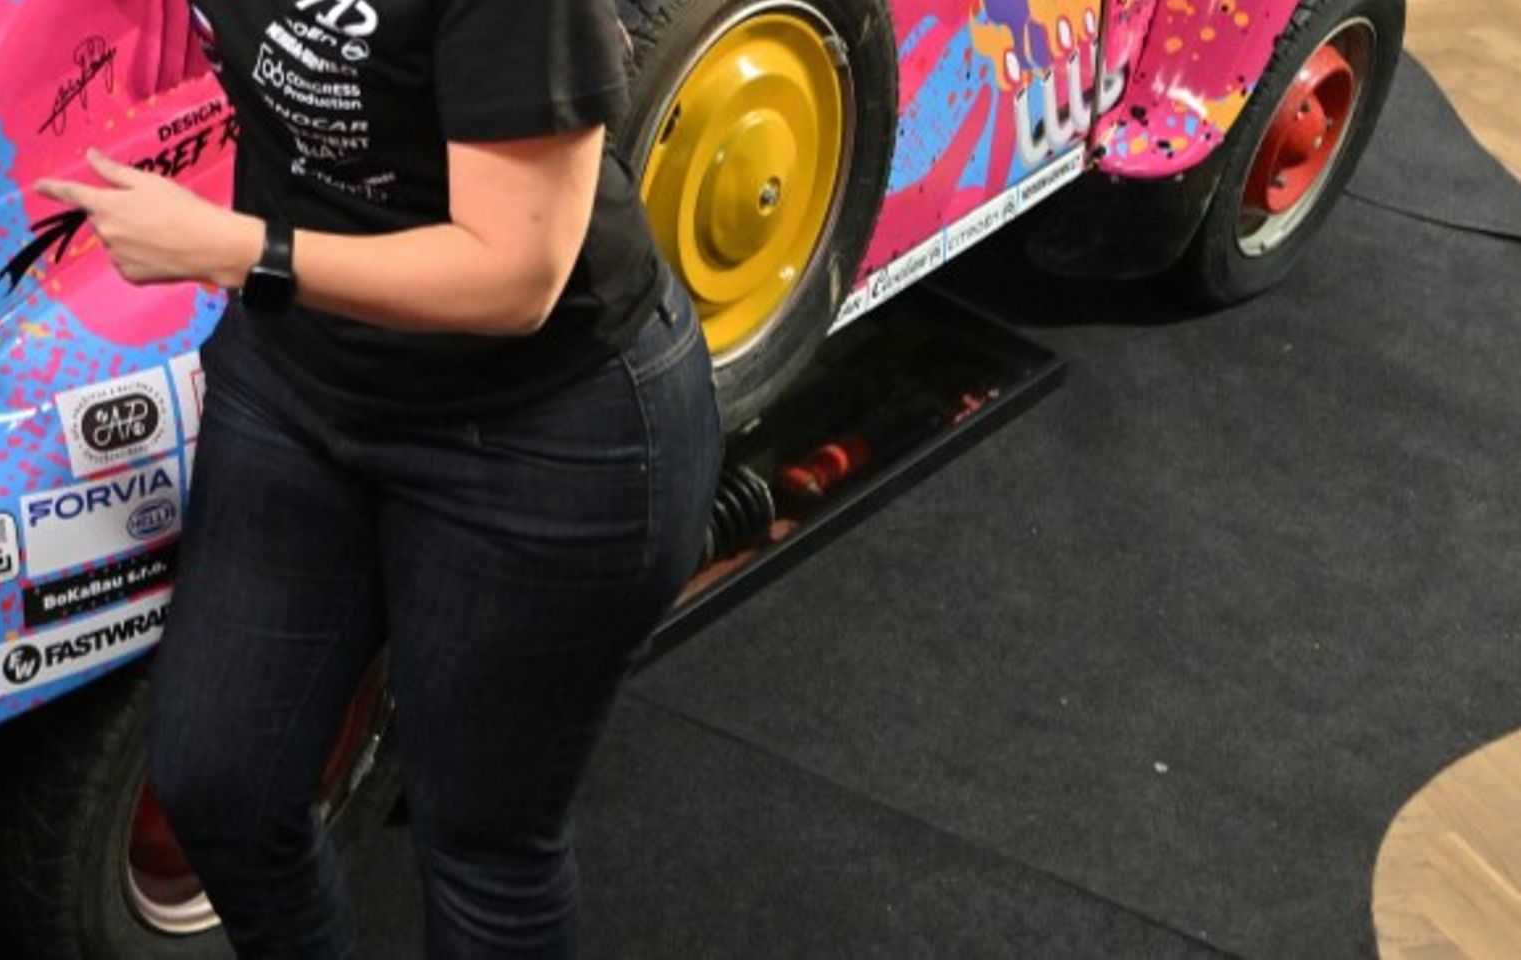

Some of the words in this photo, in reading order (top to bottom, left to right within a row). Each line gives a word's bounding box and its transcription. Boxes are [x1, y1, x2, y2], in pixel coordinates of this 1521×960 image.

[157, 99, 222, 142] DESIGN
[282, 84, 363, 111] Production
[28, 466, 174, 528] FORVIA
[43, 576, 123, 611] BoKaBau
[126, 562, 168, 583] s.r.o.
